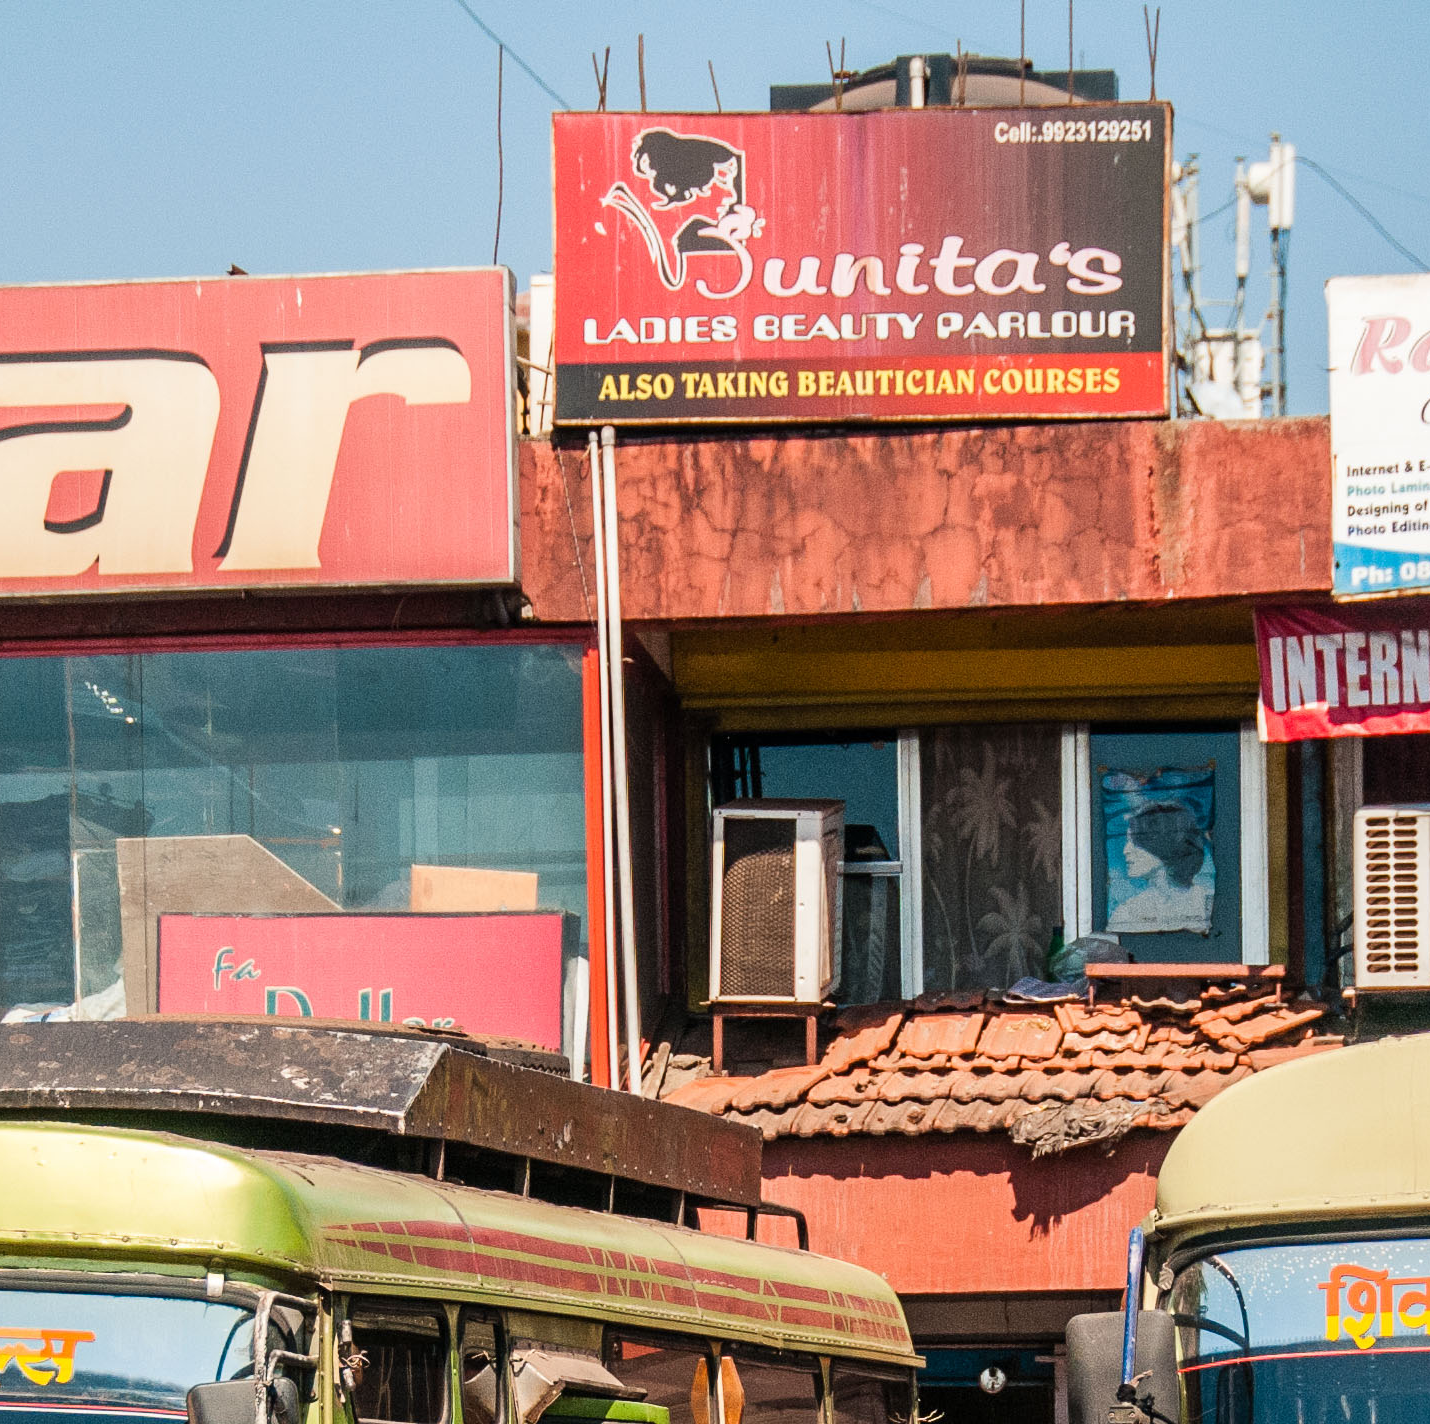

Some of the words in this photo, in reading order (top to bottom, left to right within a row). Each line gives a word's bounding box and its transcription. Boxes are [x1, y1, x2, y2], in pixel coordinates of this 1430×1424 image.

[583, 314, 739, 345] LADIES
[753, 311, 924, 342] BEAUTY
[935, 310, 1137, 340] PARLOUR
[598, 374, 675, 401] ALSO
[680, 372, 790, 399] TAKING
[797, 370, 975, 397] BEAUTICIAN
[983, 367, 1122, 395] COURSES
[1346, 463, 1400, 478] Internet
[1404, 460, 1414, 473] &
[1346, 483, 1386, 498] Photo
[1346, 502, 1410, 518] Designing
[1414, 499, 1429, 513] of
[1346, 522, 1386, 537] Photo
[1350, 564, 1393, 588] Ph:
